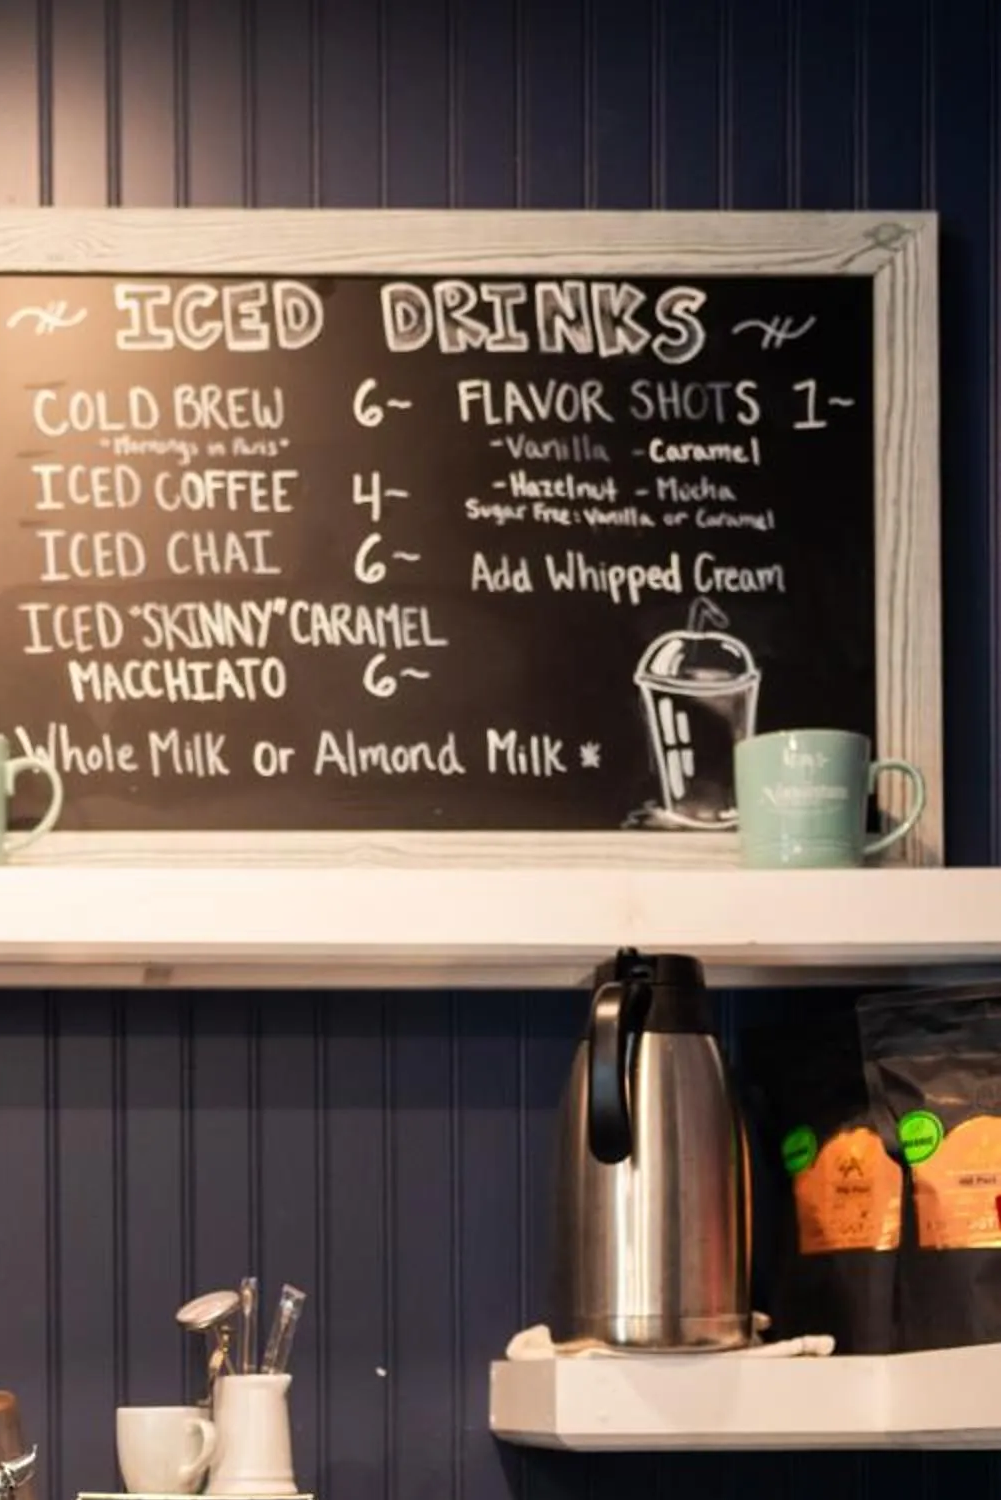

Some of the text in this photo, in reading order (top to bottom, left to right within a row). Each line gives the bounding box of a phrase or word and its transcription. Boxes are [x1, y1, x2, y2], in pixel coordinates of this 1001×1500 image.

[115, 280, 707, 363] ICED DRINKS
[33, 386, 160, 436] COLD
[173, 384, 284, 430] BREW
[458, 379, 614, 425] FLAVOR
[630, 380, 760, 425] SHOTS
[207, 436, 225, 456] in
[32, 464, 141, 510] ICED
[155, 469, 298, 513] COFFEE
[465, 498, 526, 526] Sugar
[584, 506, 655, 527] Vanilla
[663, 511, 689, 526] or
[695, 508, 775, 532] Caramel
[37, 528, 146, 582] ICED
[166, 529, 282, 577] CHAI
[471, 551, 785, 604] Add Whipped Cream
[19, 602, 124, 654] ICED
[289, 601, 449, 647] CARAMEL
[68, 656, 287, 702] MACCHIATO
[15, 722, 568, 777] Whole Milk or Almond Milk
